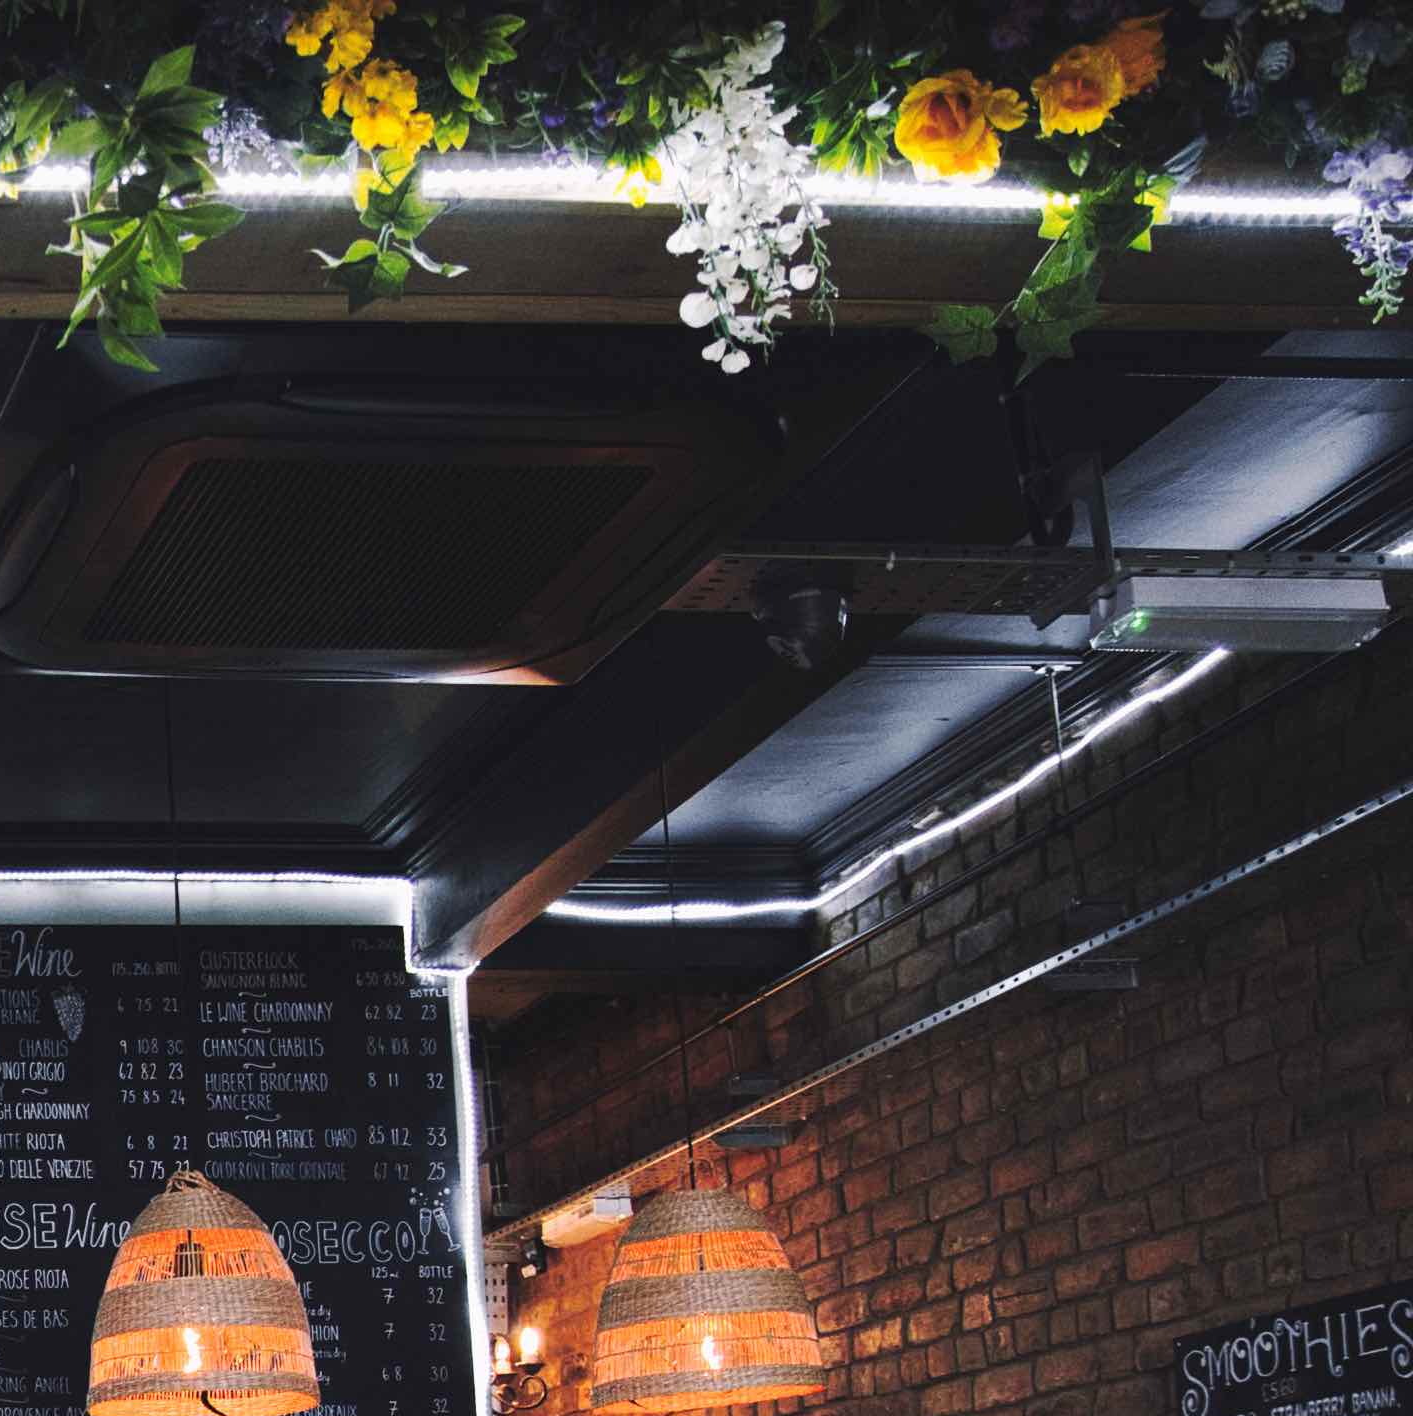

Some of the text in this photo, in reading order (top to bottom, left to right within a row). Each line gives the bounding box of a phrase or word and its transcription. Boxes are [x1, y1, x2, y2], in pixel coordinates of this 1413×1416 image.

[11, 926, 82, 977] Wine
[200, 1001, 334, 1023] LE WINE CHARDONNAY
[203, 1037, 324, 1057] CHANSON CHABLIS
[30, 1062, 65, 1081] GRIGIO
[205, 1072, 329, 1092] HUBERT BROCHARD
[206, 1093, 272, 1111] SANCERRE
[16, 1103, 91, 1121] CHARDONNAY
[26, 1132, 65, 1151] RIOJA
[207, 1128, 316, 1149] CHRISTOPH PATRICE
[10, 1158, 43, 1179] DELLE
[49, 1159, 94, 1179] VENEZIE
[35, 1270, 69, 1289] RIOJA
[419, 1266, 454, 1279] BOTTLE
[23, 1310, 36, 1328] DE
[43, 1309, 69, 1328] BAS
[34, 1376, 72, 1394] ANGEL
